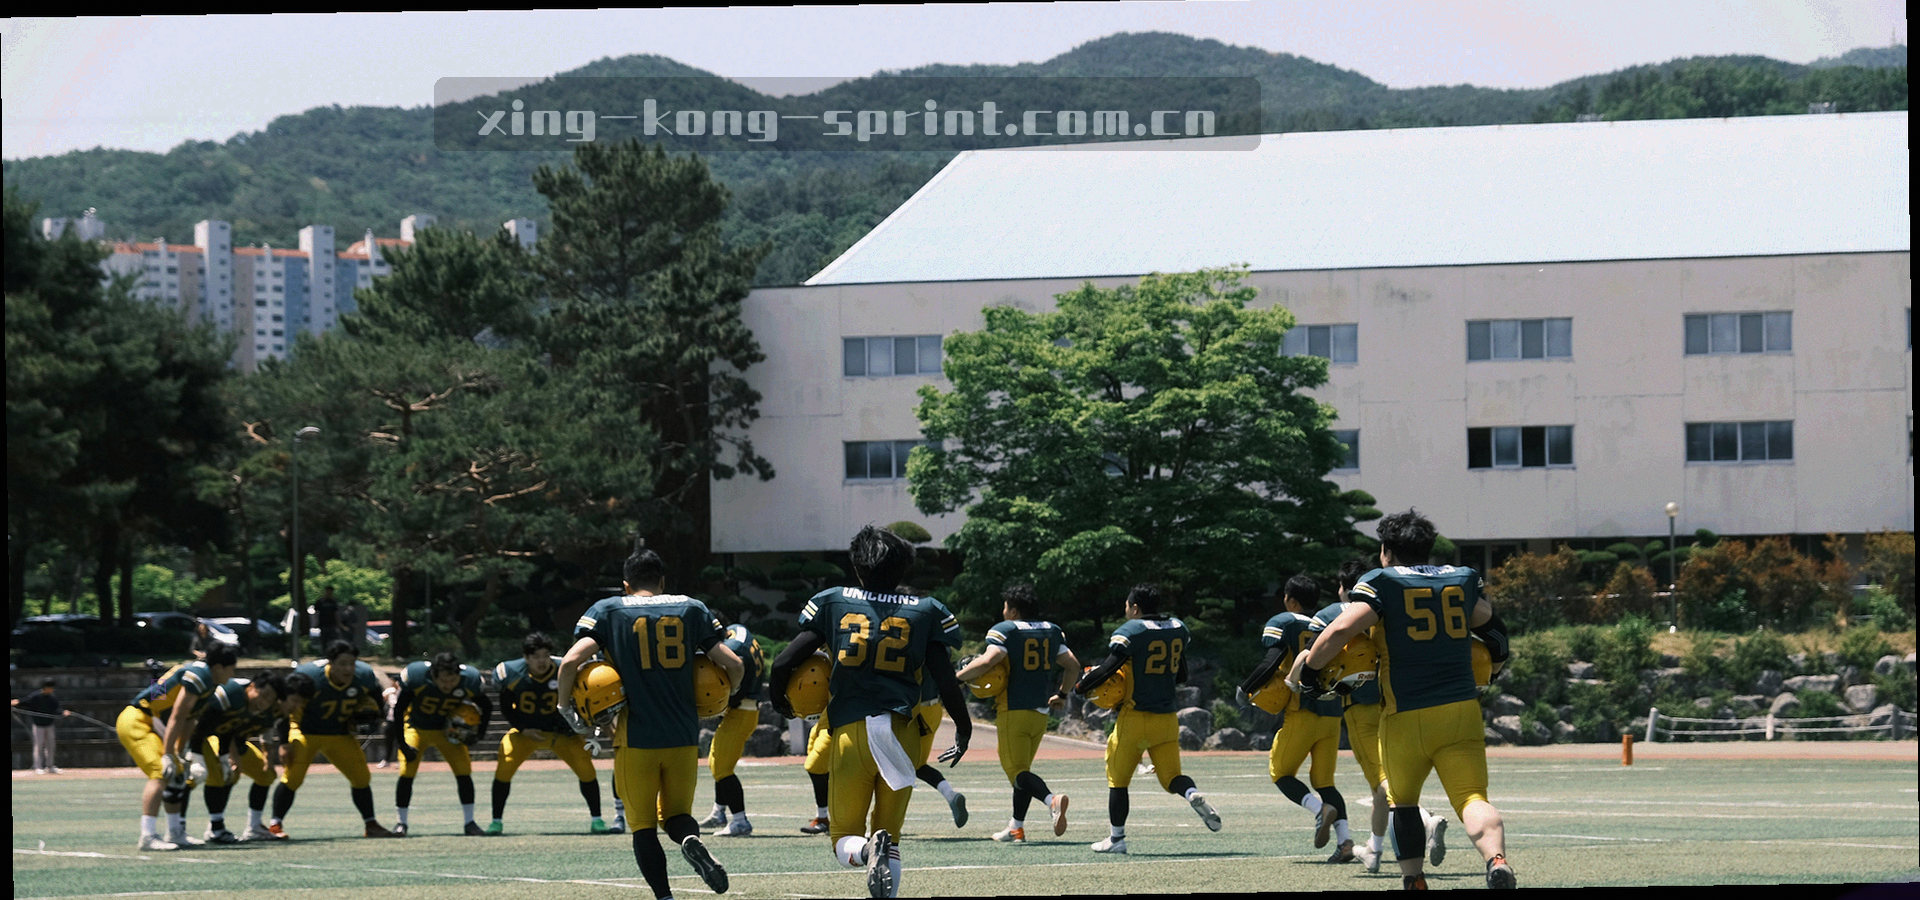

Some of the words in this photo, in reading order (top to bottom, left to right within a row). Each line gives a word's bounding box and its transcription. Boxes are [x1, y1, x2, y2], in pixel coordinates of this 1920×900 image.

[1403, 586, 1468, 641] 56
[632, 616, 686, 670] 18
[837, 612, 911, 673] 32
[1023, 637, 1051, 671] 61
[1144, 637, 1183, 675] 28
[320, 698, 358, 722] 75
[419, 696, 460, 716] 55
[519, 690, 558, 715] 63
